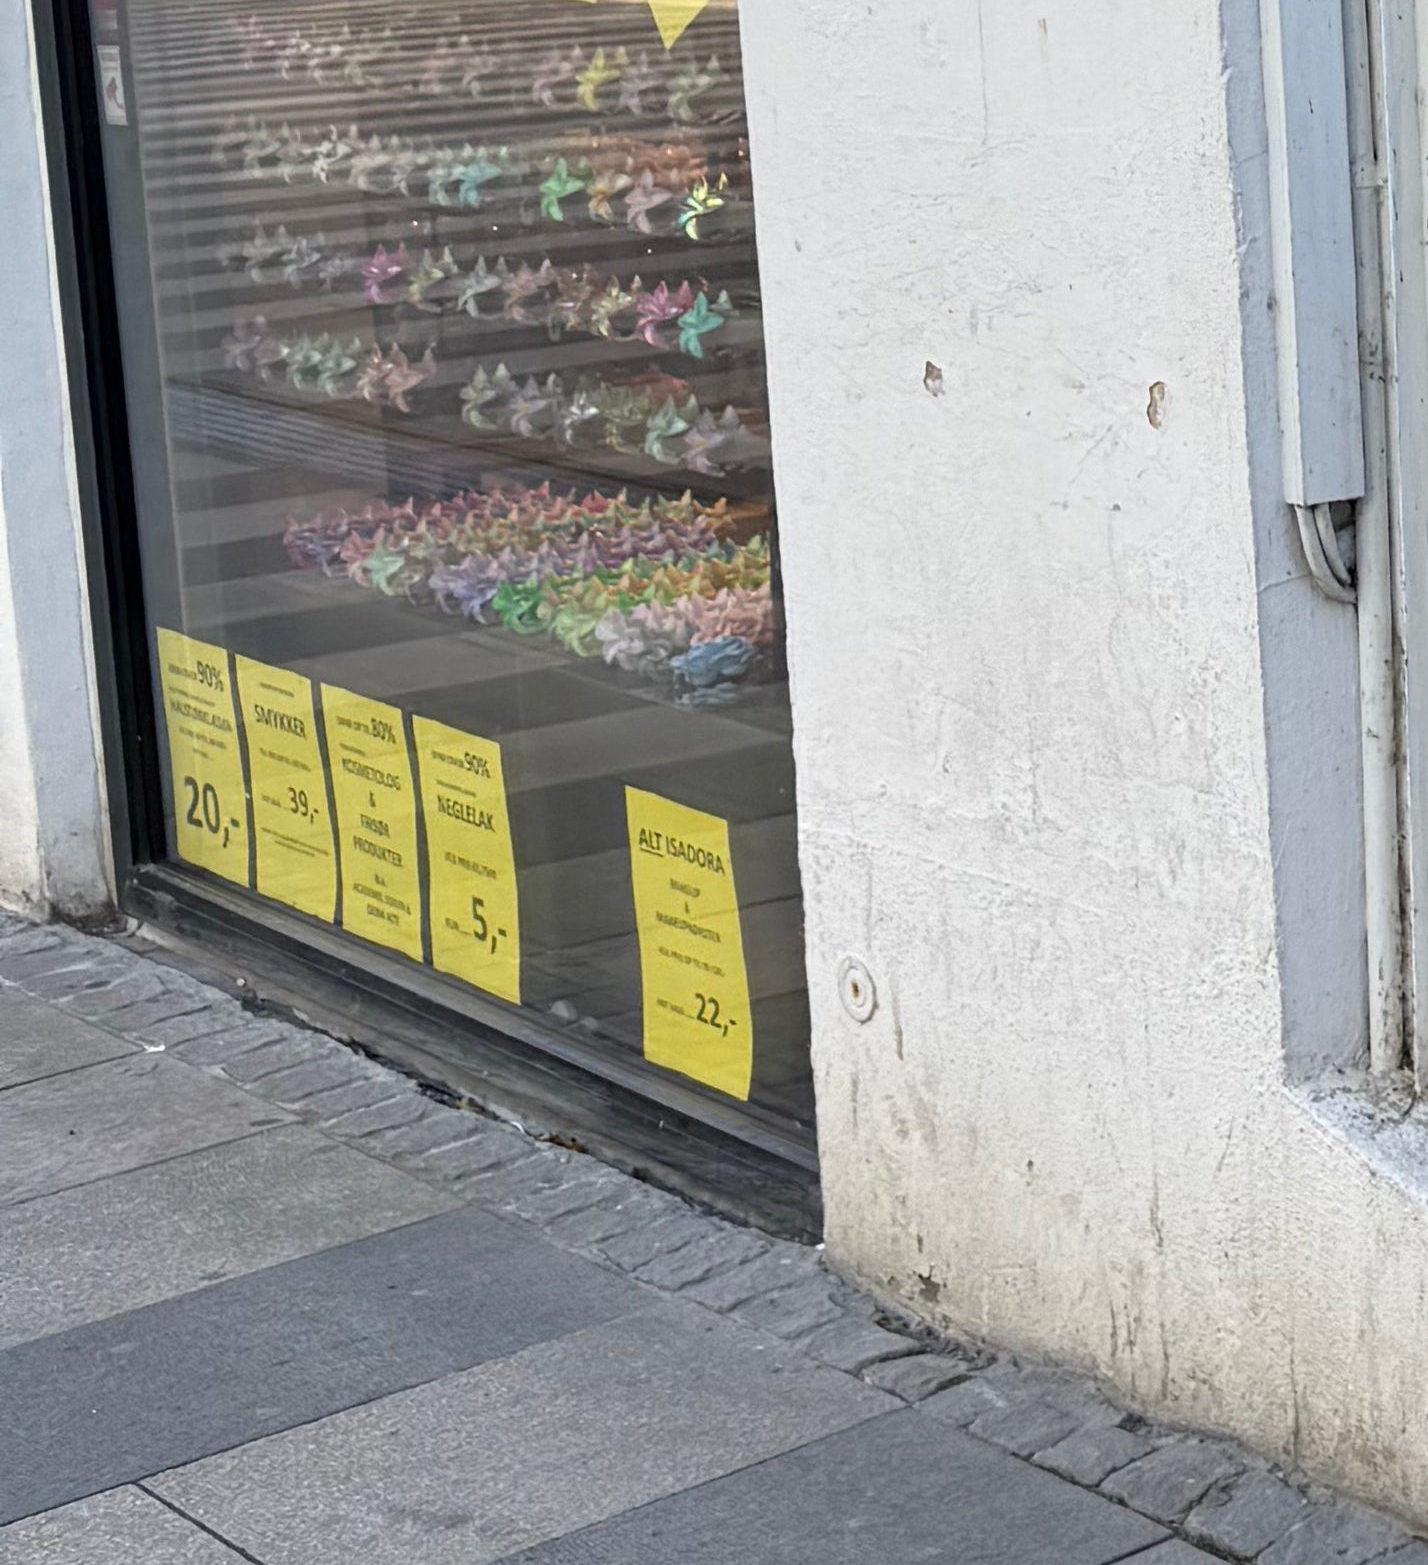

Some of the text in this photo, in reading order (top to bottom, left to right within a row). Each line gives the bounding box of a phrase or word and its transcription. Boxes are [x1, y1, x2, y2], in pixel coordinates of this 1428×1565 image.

[196, 660, 224, 692] 90%
[254, 703, 306, 738] SMYKKER
[184, 776, 240, 849] 20,-
[287, 787, 320, 825] 39,-
[437, 794, 496, 833] NEGLELAK
[639, 828, 726, 876] ALT ISADORA
[471, 894, 507, 955] 5,-
[695, 992, 737, 1038] 22,-
